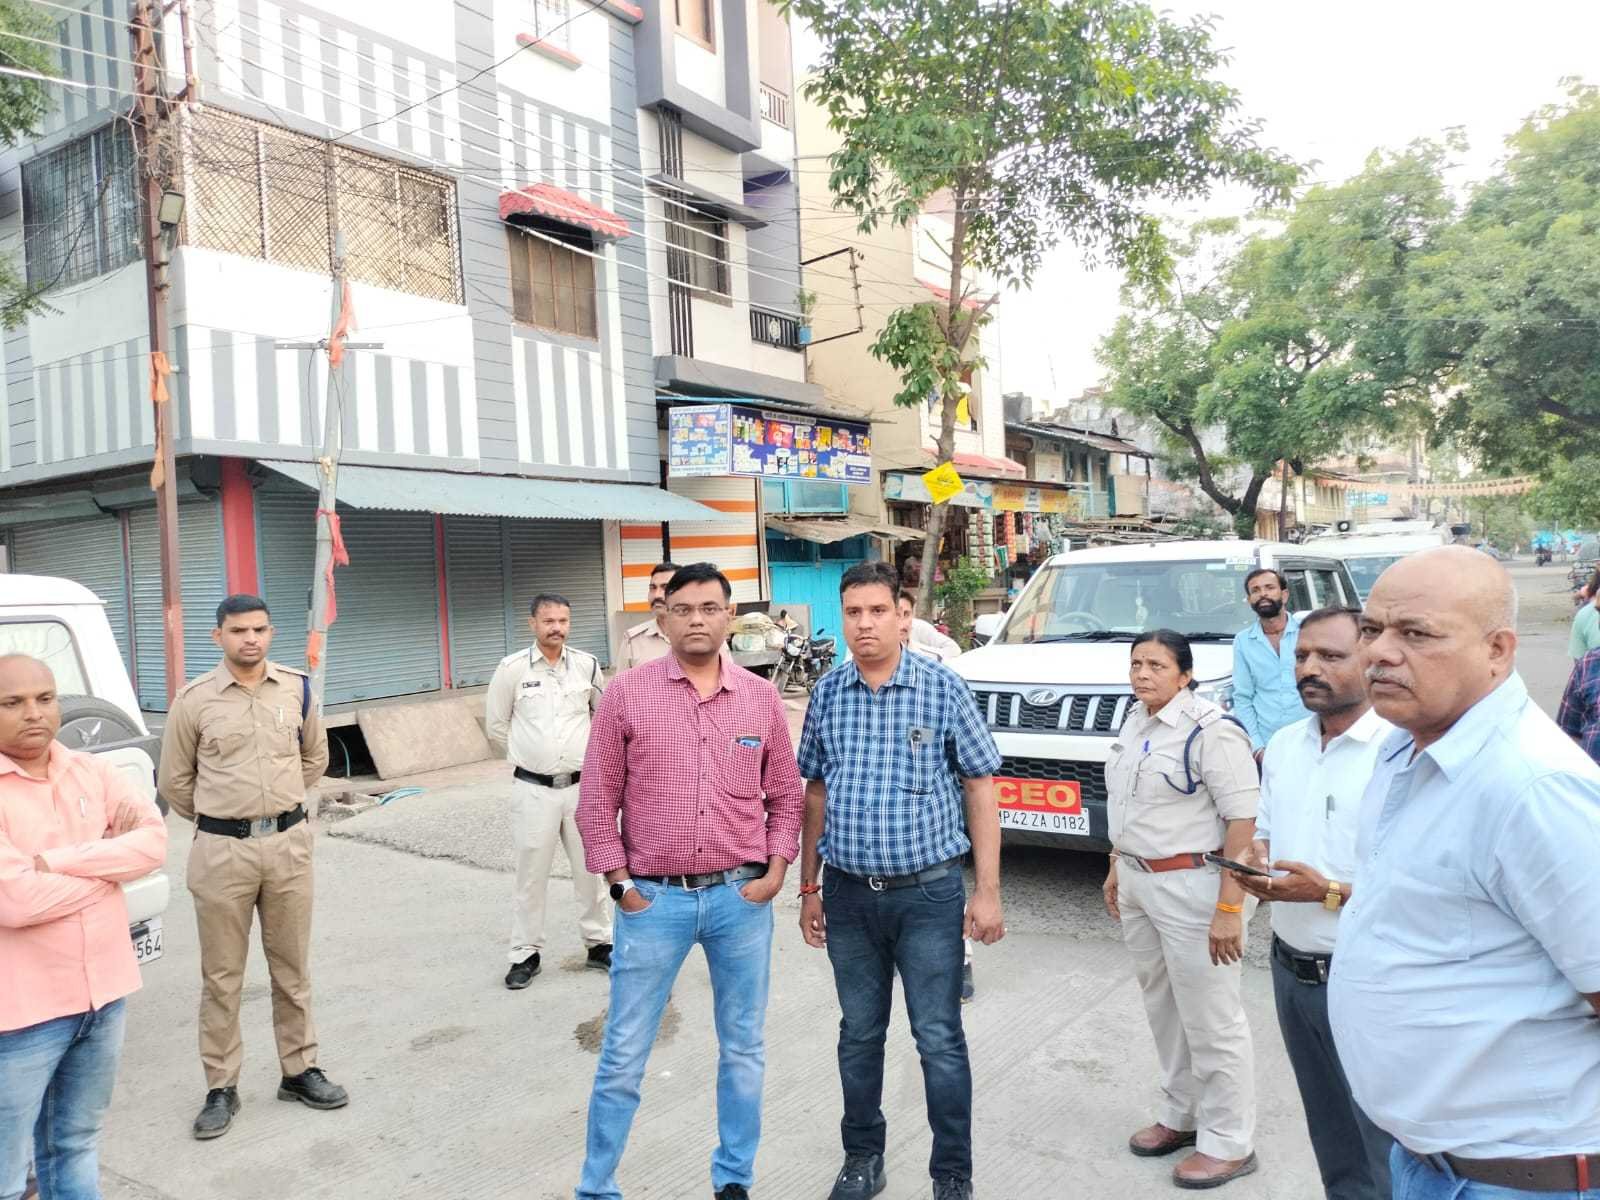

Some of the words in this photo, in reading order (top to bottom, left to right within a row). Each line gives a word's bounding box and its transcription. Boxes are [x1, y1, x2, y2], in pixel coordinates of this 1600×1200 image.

[993, 781, 1076, 808] CEO
[1053, 815, 1086, 830] 0182
[133, 935, 161, 959] 564
